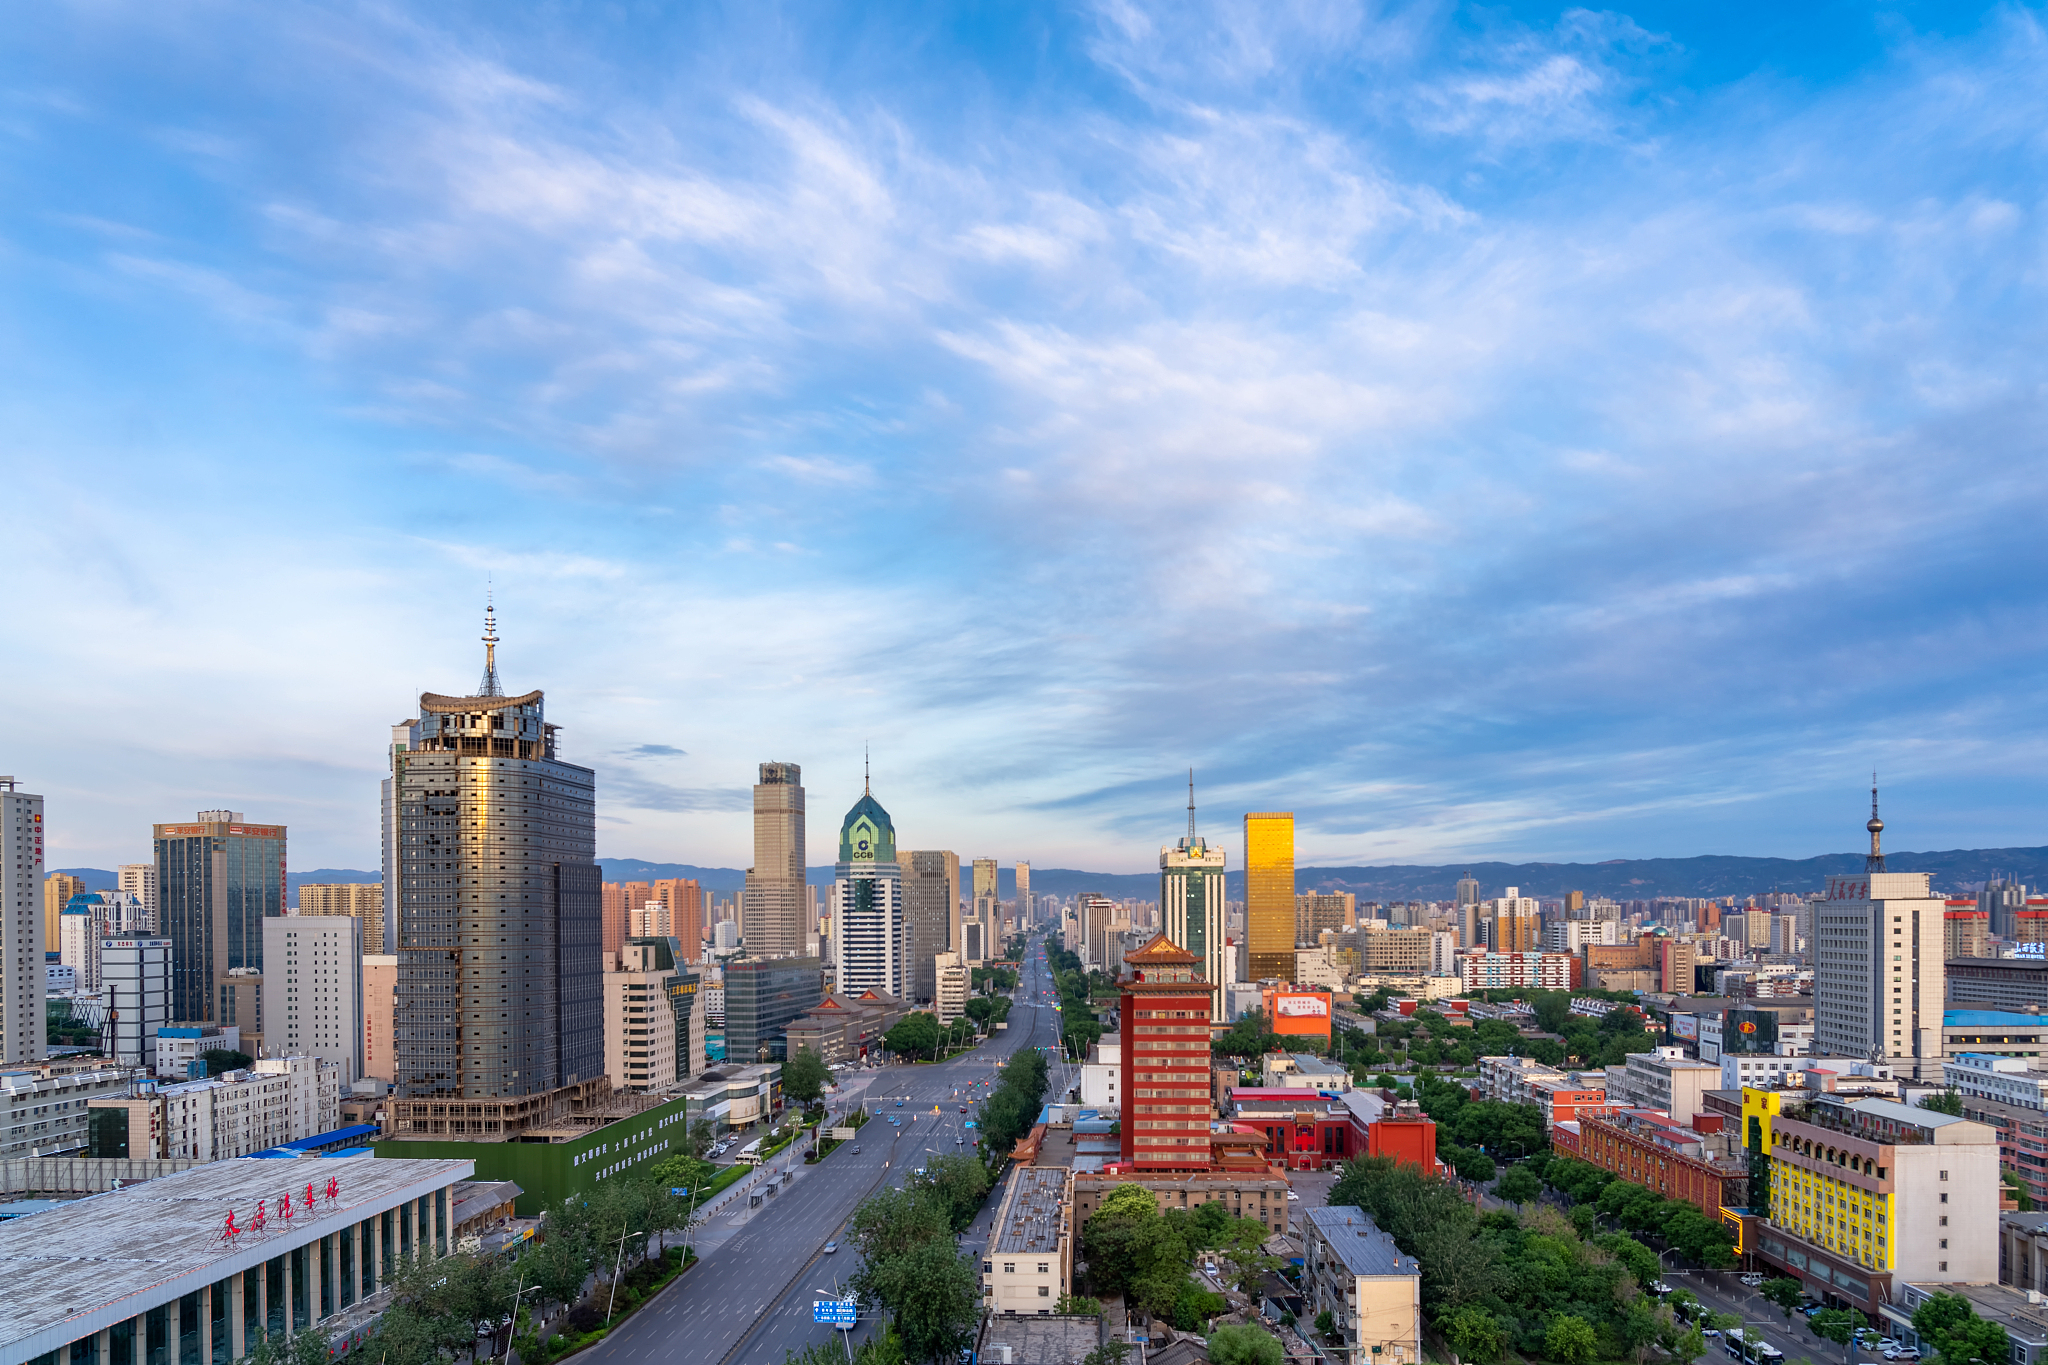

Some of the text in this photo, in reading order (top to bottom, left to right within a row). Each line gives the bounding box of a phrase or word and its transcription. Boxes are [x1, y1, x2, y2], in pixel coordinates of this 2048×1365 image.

[176, 825, 205, 835] 平安银行
[243, 826, 277, 837] 平安银行
[853, 851, 873, 859] CCB
[1743, 1091, 1768, 1110] 如家
[221, 1176, 340, 1239] 太原汽车站
